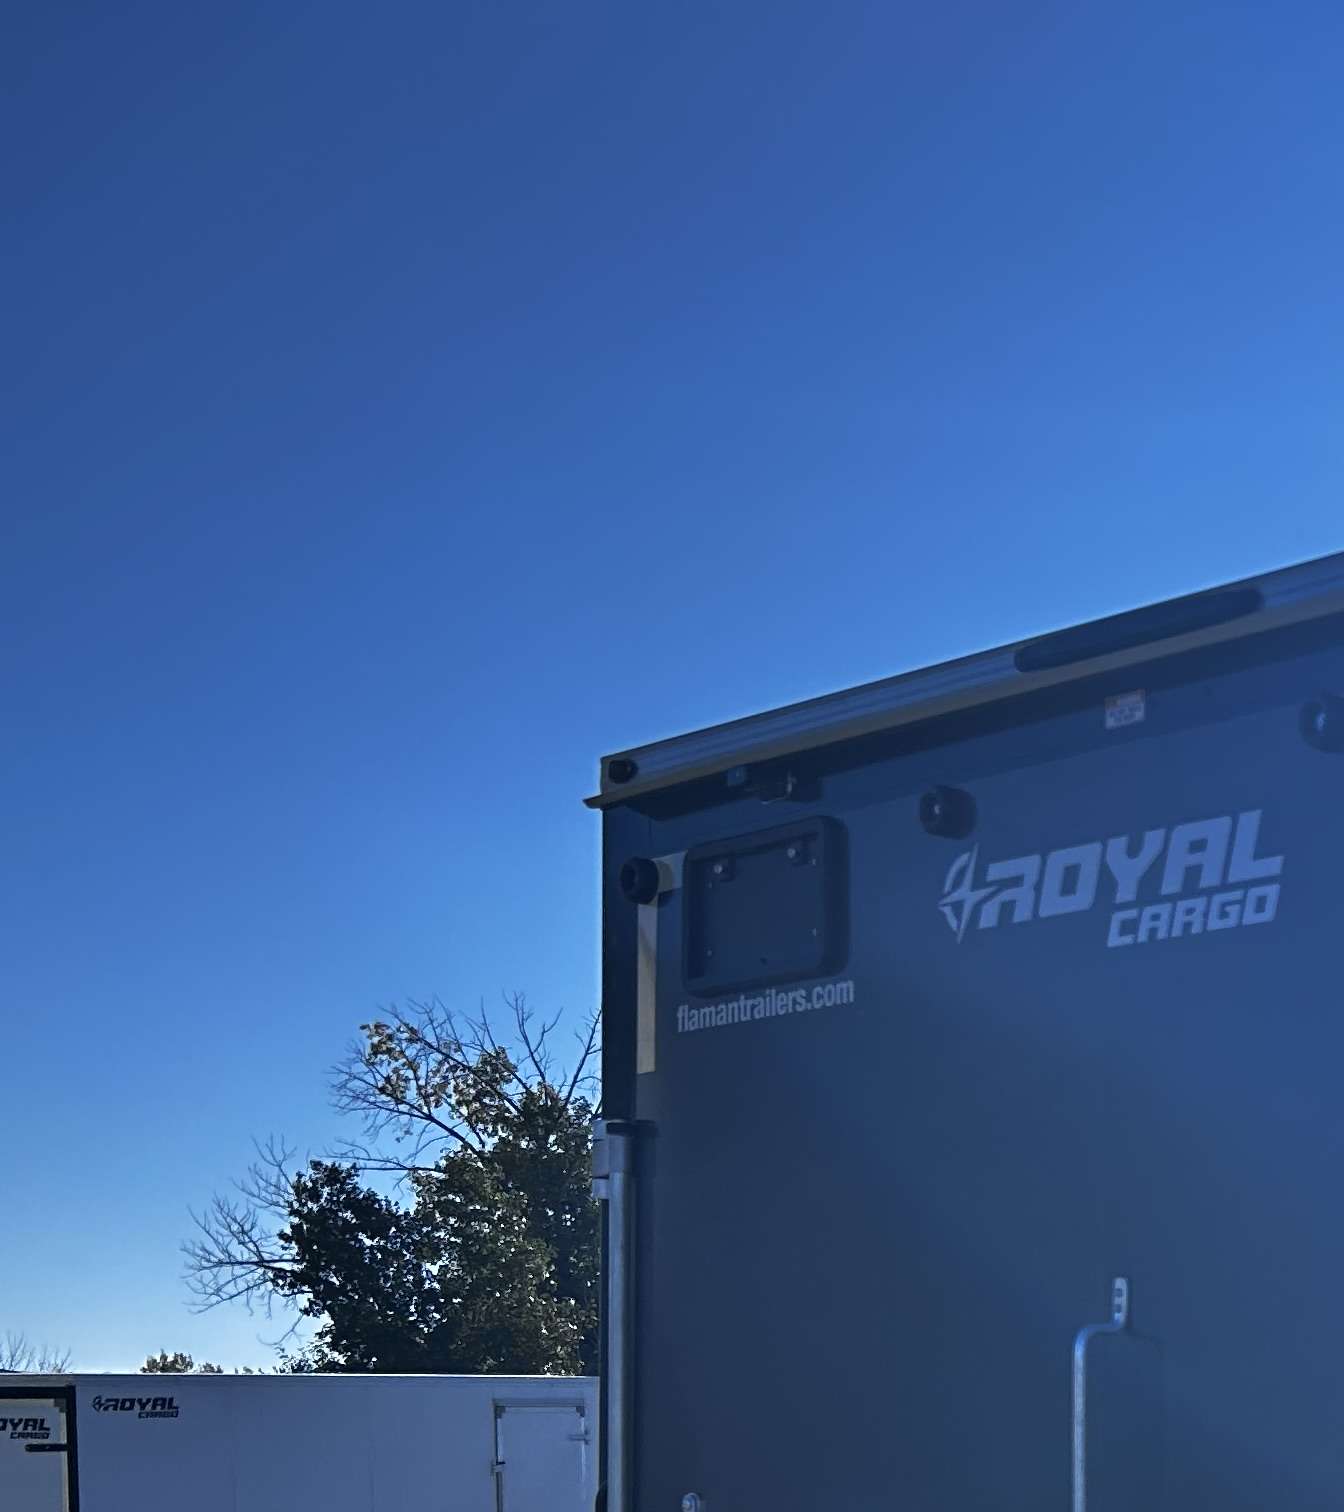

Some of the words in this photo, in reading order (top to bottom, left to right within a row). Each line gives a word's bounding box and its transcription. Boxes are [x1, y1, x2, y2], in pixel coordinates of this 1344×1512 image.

[977, 809, 1285, 930] ROYAL
[1107, 884, 1281, 948] CARGO
[676, 979, 855, 1033] flamantrailers.com
[103, 1397, 179, 1411] ROYAL
